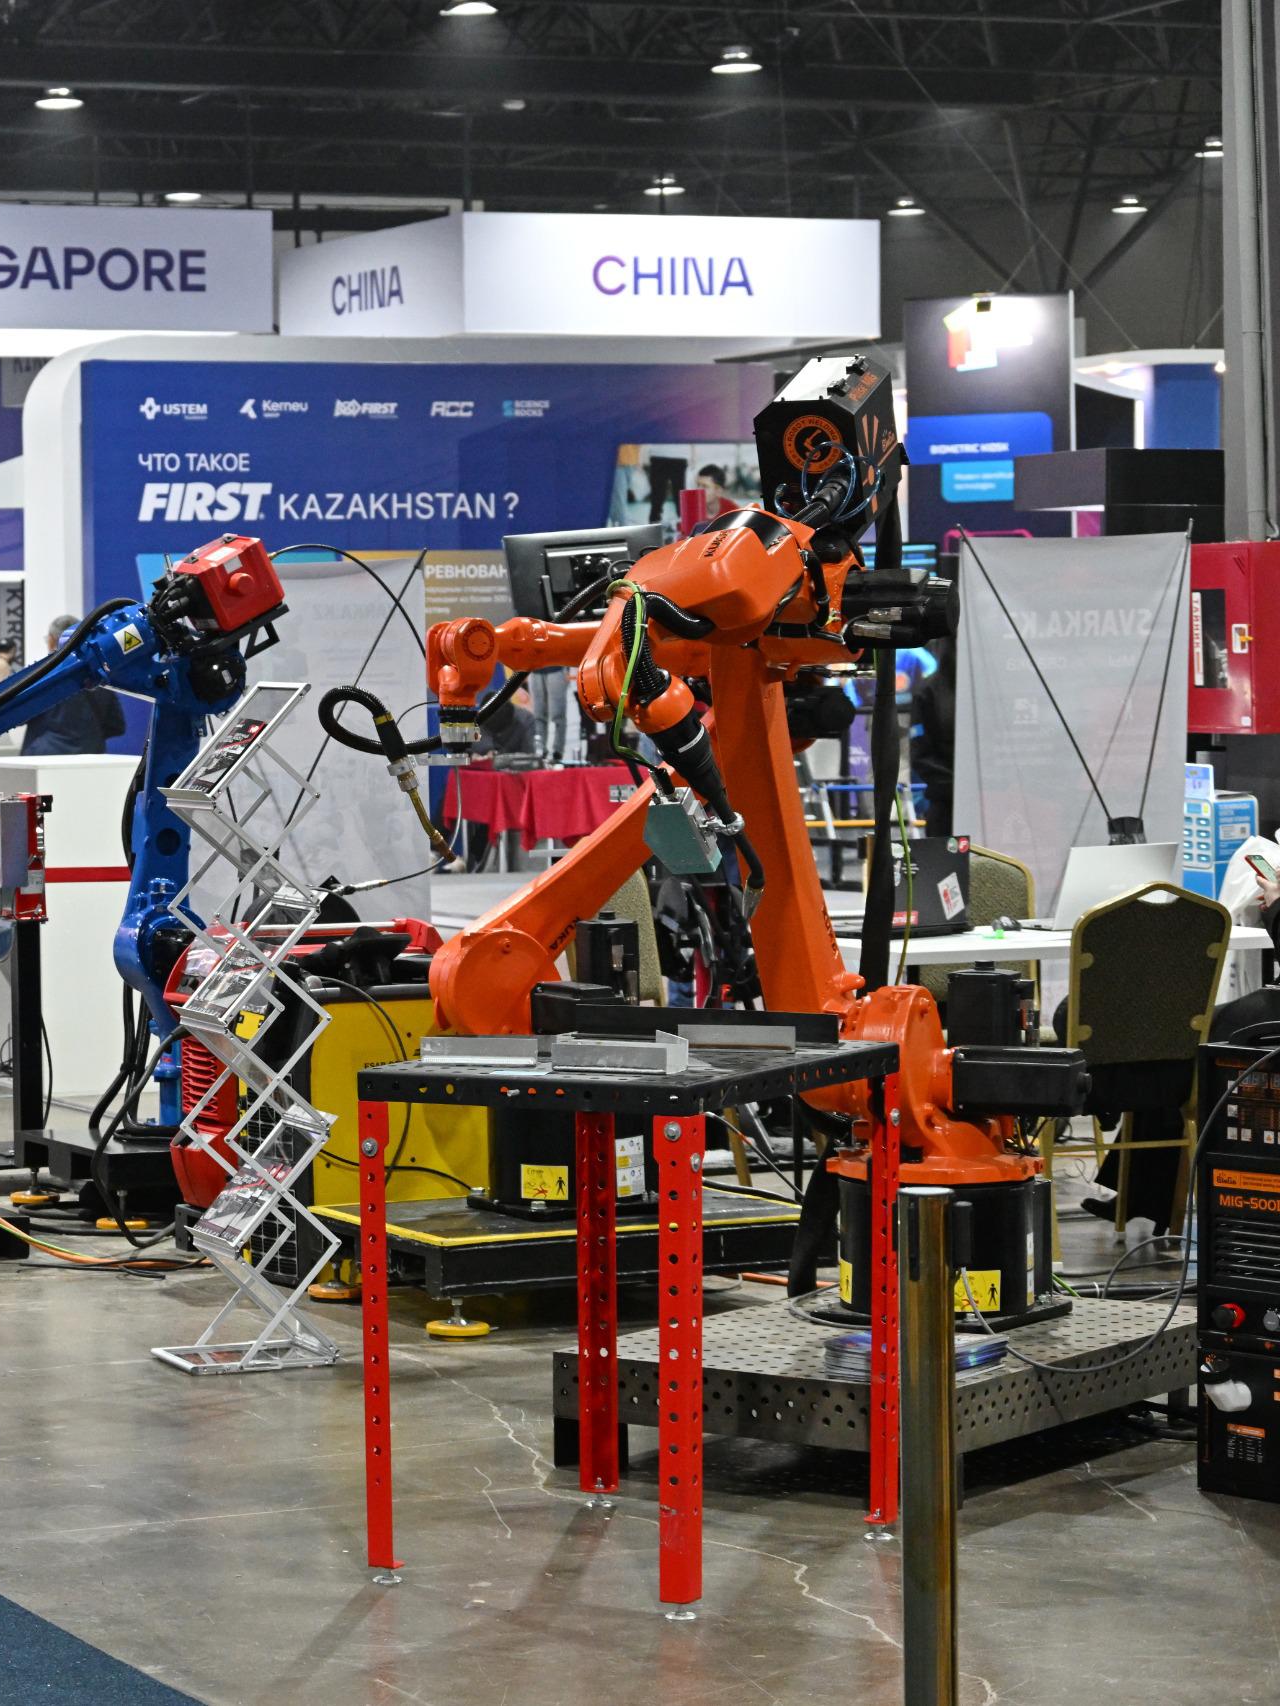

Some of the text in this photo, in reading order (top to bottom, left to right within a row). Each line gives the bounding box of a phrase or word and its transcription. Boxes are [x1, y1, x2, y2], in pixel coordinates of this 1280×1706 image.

[331, 265, 403, 315] CHINA
[592, 255, 754, 296] CHINA
[163, 403, 208, 415] USTEM
[262, 399, 308, 412] Kerneu
[138, 453, 250, 472] ЧТО ТАКОЕ
[138, 482, 272, 521] FIRST
[279, 493, 495, 520] KAZAKHSTAN
